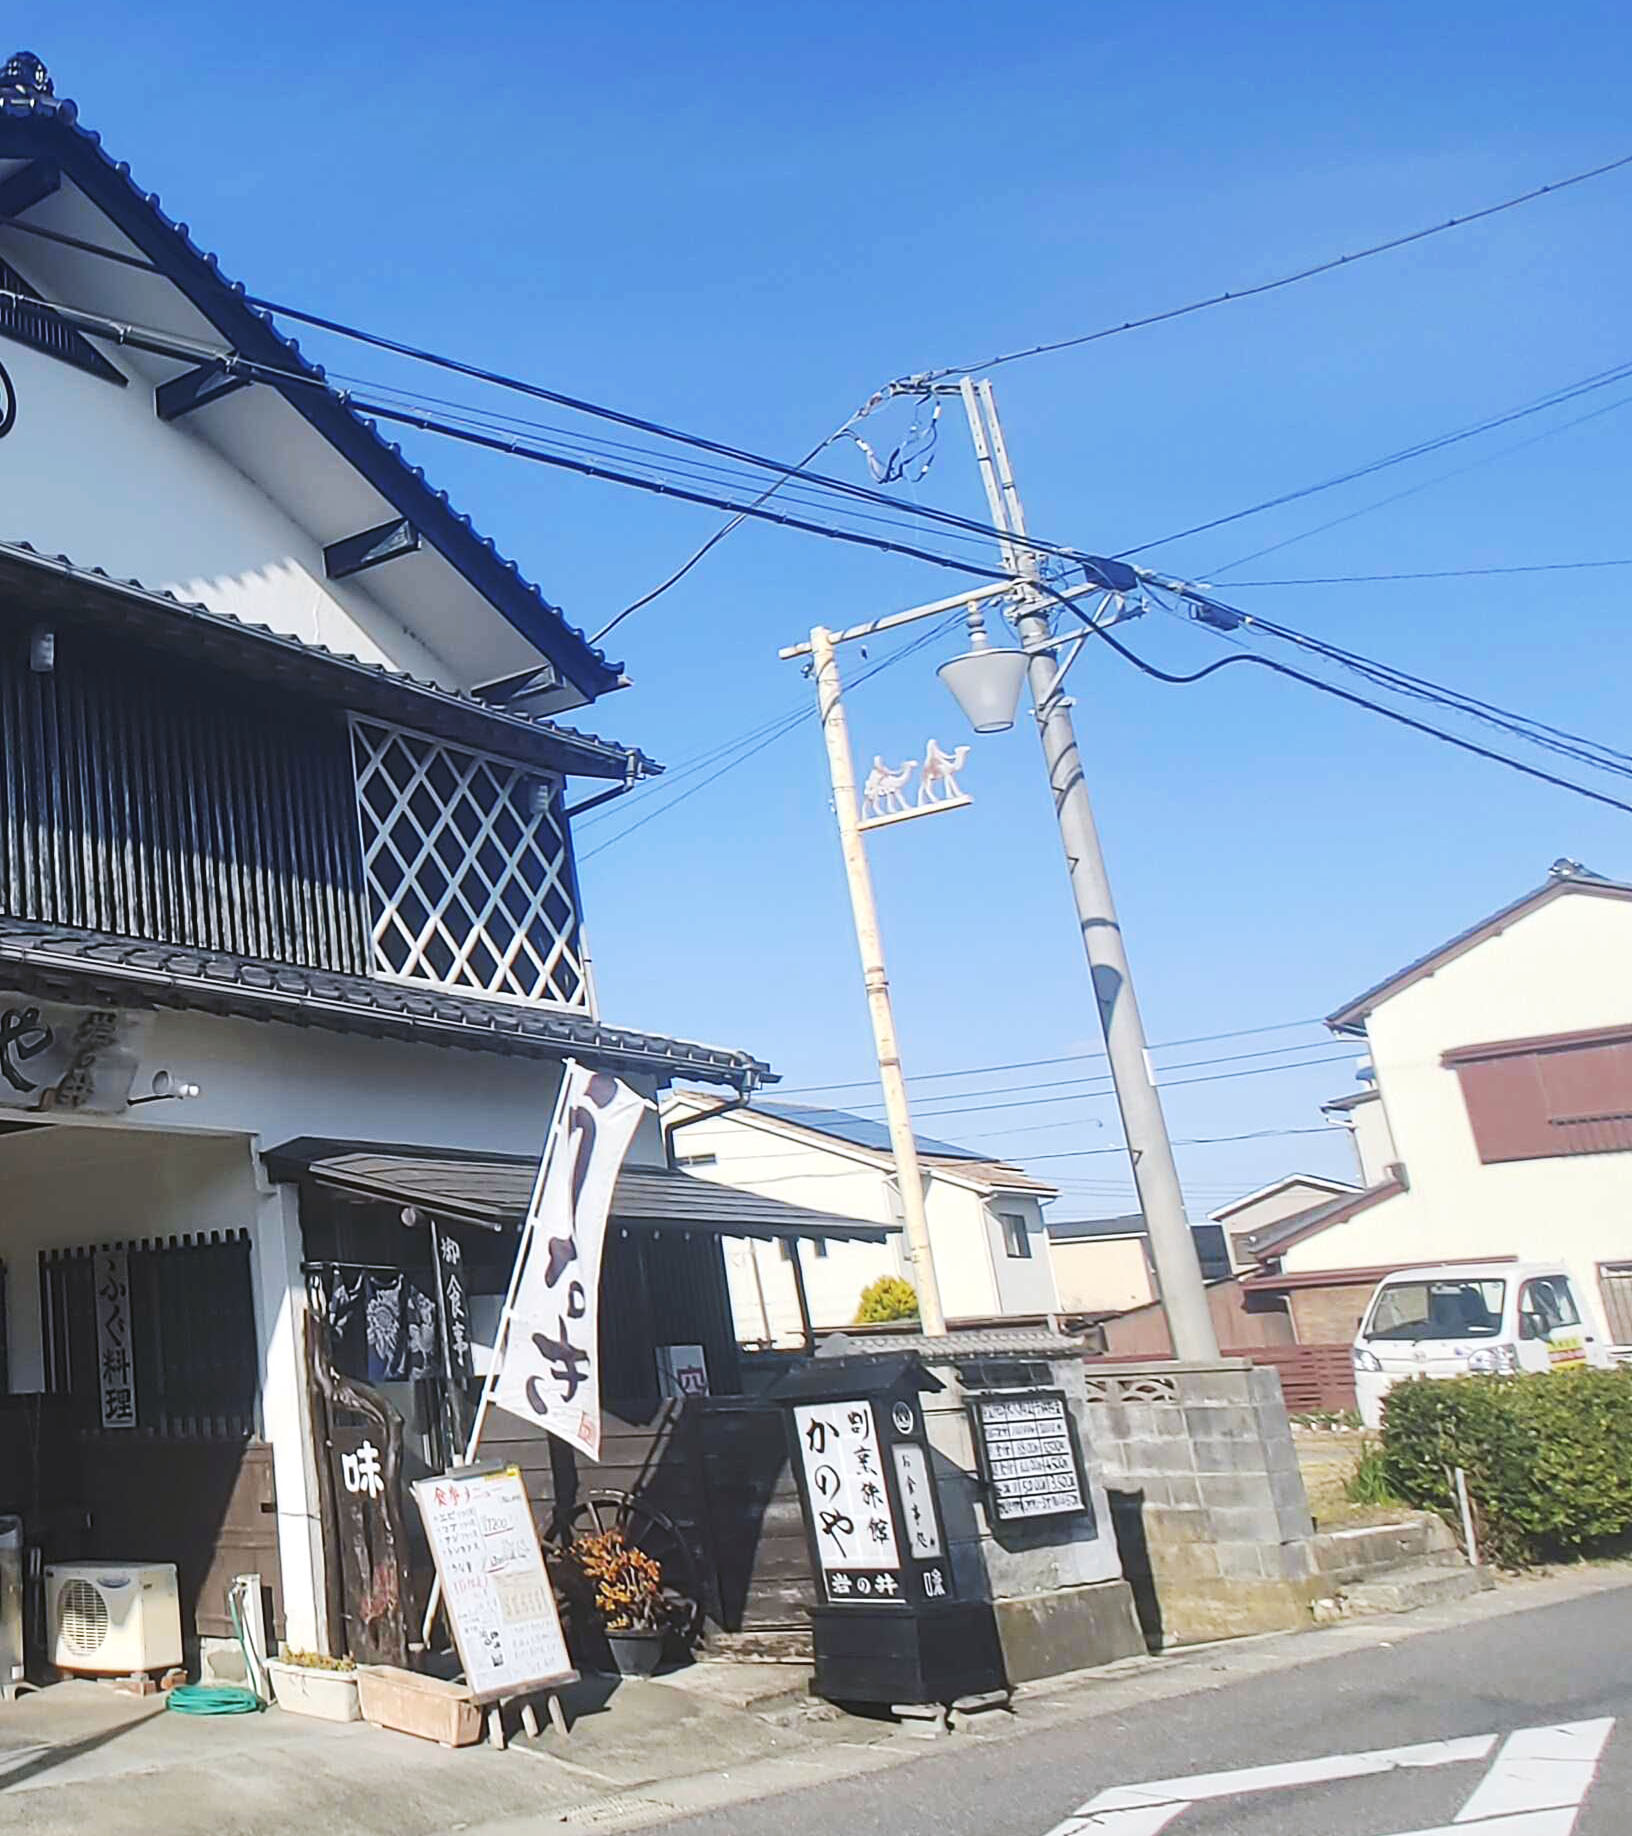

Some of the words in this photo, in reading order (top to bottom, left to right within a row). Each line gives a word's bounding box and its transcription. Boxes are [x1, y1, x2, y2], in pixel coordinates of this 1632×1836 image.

[99, 1259, 133, 1420] ふぐ料理
[440, 1236, 469, 1367] 御食事
[341, 1440, 384, 1499] 味
[805, 1417, 855, 1559] かのや
[831, 1573, 899, 1596] 岩の井
